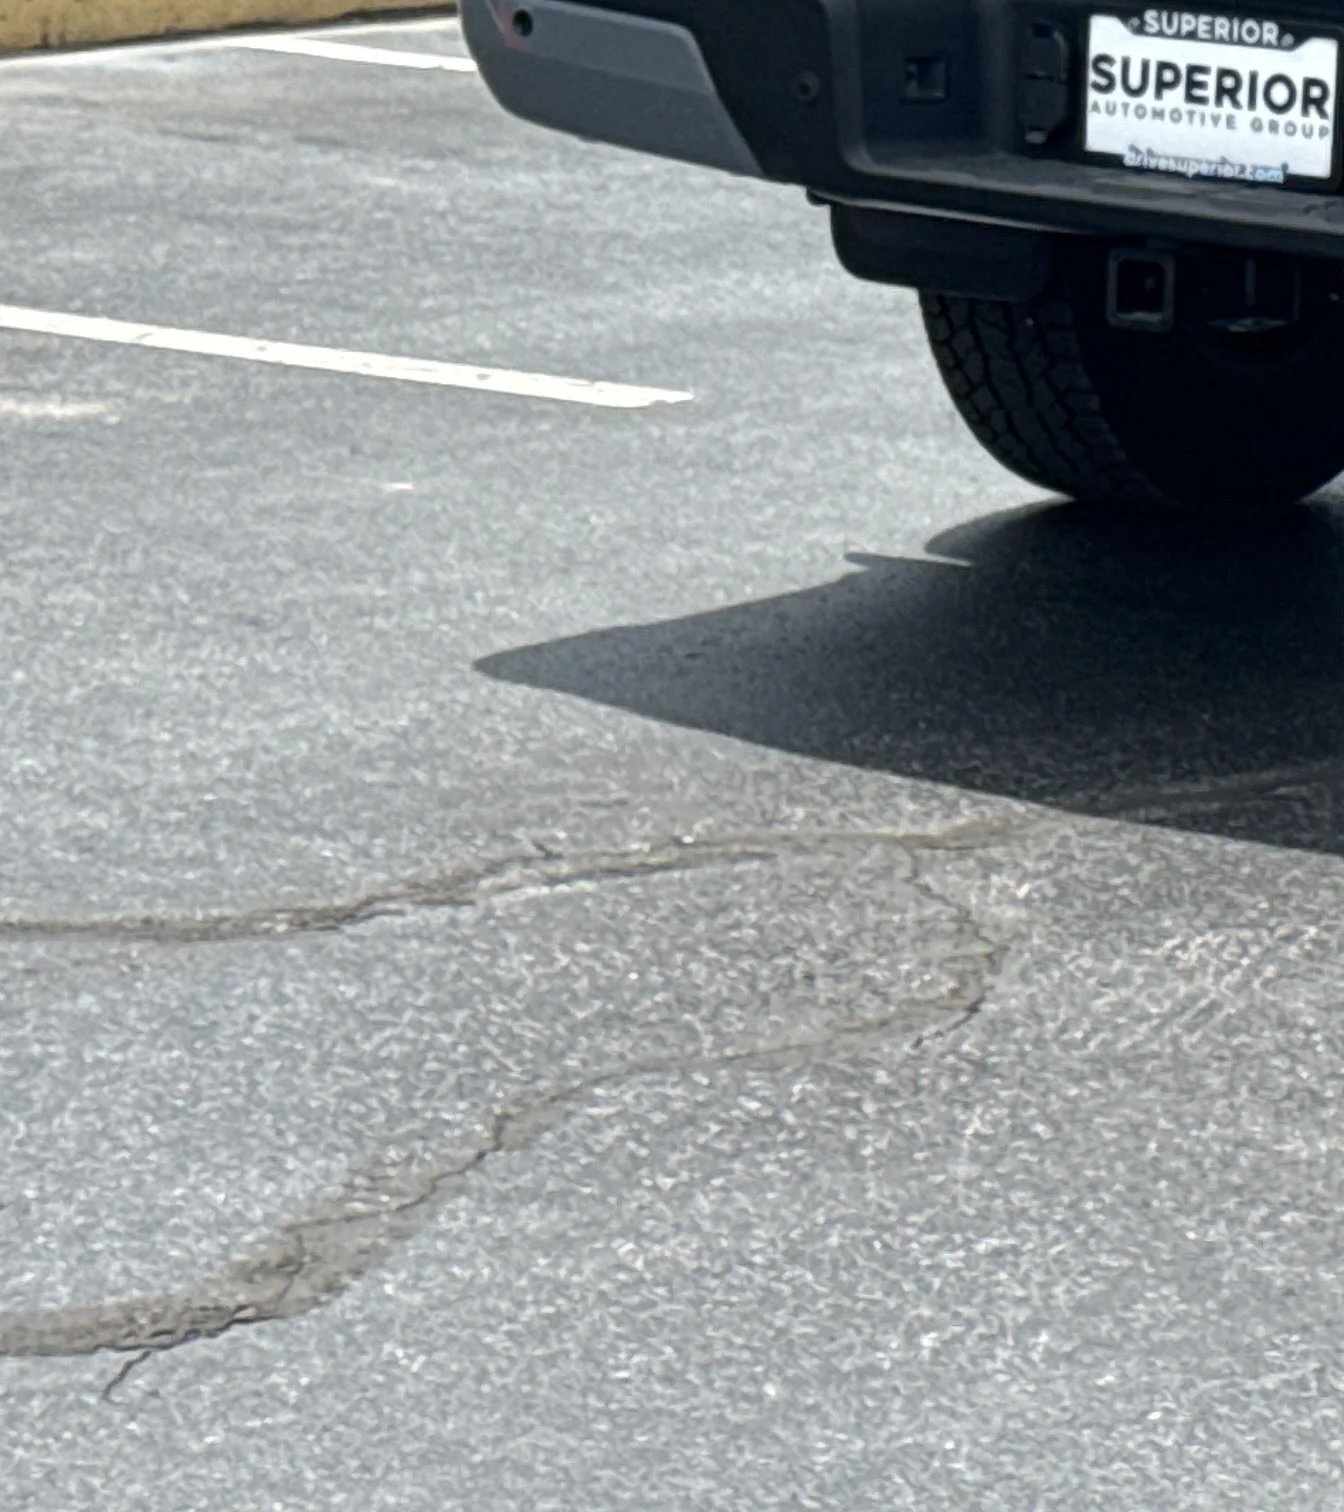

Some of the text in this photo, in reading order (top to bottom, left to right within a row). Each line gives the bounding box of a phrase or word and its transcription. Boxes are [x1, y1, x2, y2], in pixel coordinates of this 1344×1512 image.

[1143, 8, 1280, 47] SUPERIOR
[1090, 53, 1330, 120] SUPERIOR
[1089, 98, 1330, 141] AUTOMOTIVE GROUP
